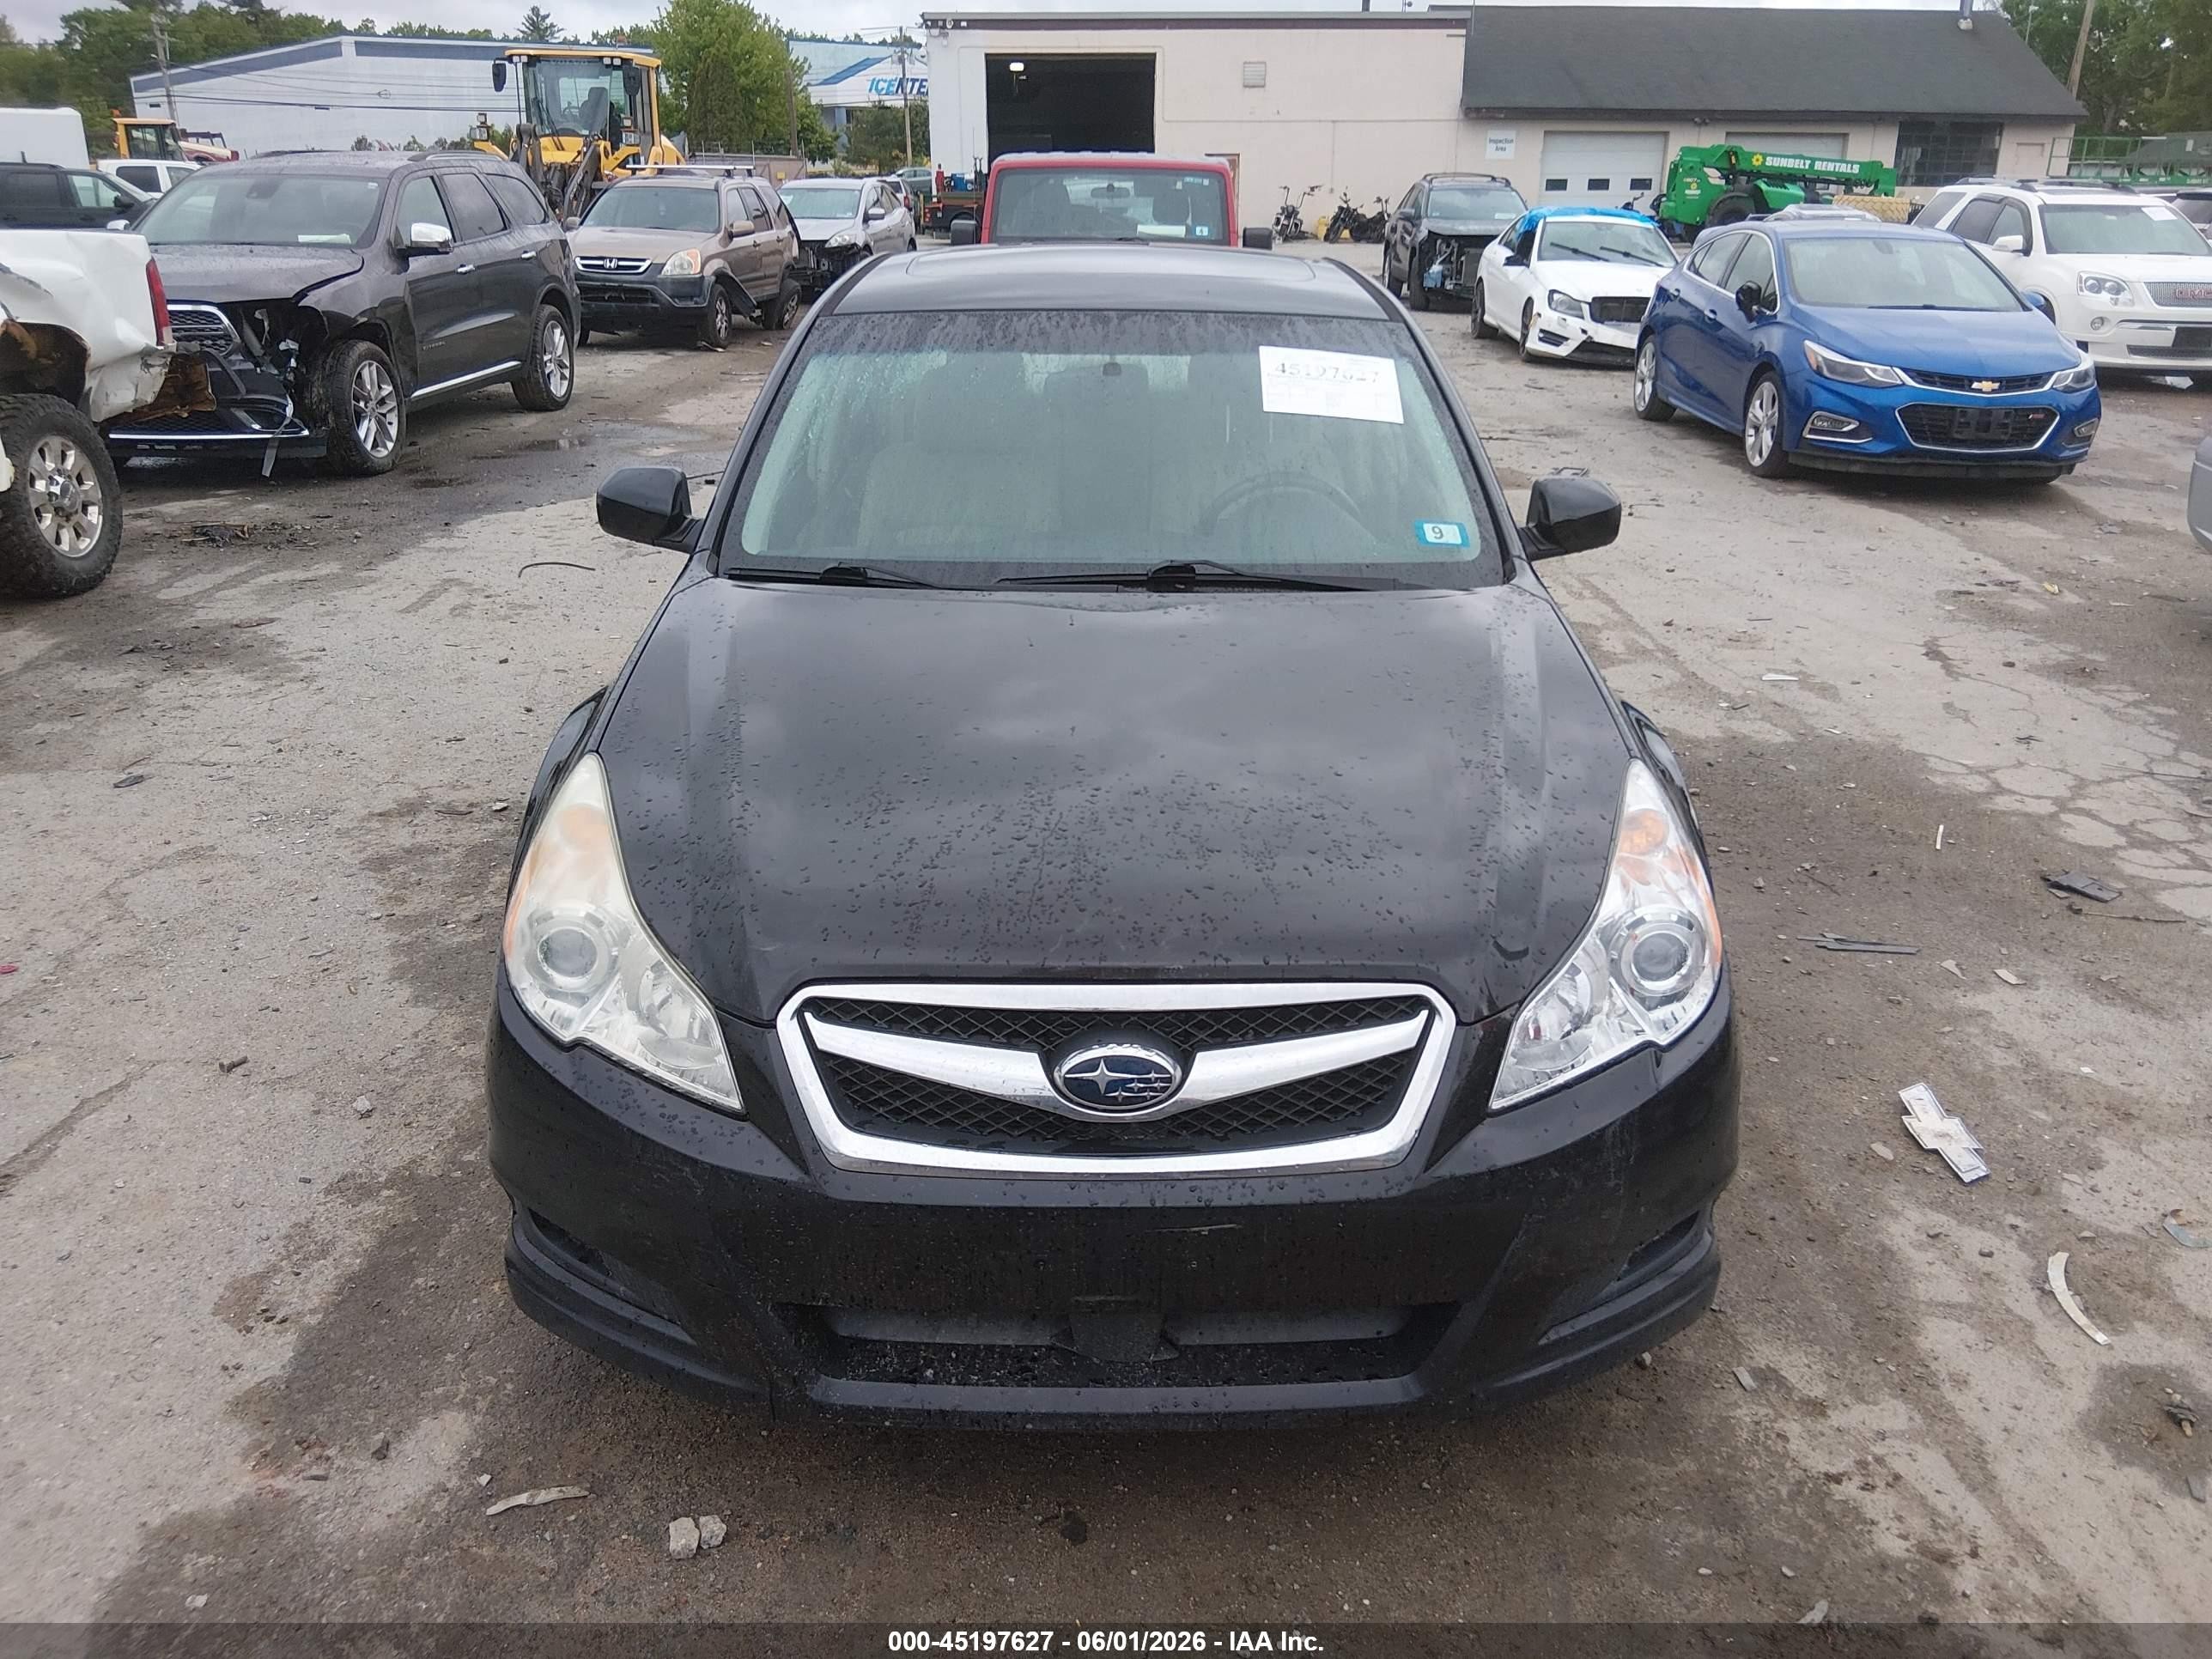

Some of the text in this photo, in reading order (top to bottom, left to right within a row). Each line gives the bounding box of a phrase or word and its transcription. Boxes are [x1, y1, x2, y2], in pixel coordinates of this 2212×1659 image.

[869, 77, 929, 96] ICENTE
[1765, 156, 1860, 173] SUNBELT RENTALS
[1431, 526, 1443, 539] 9
